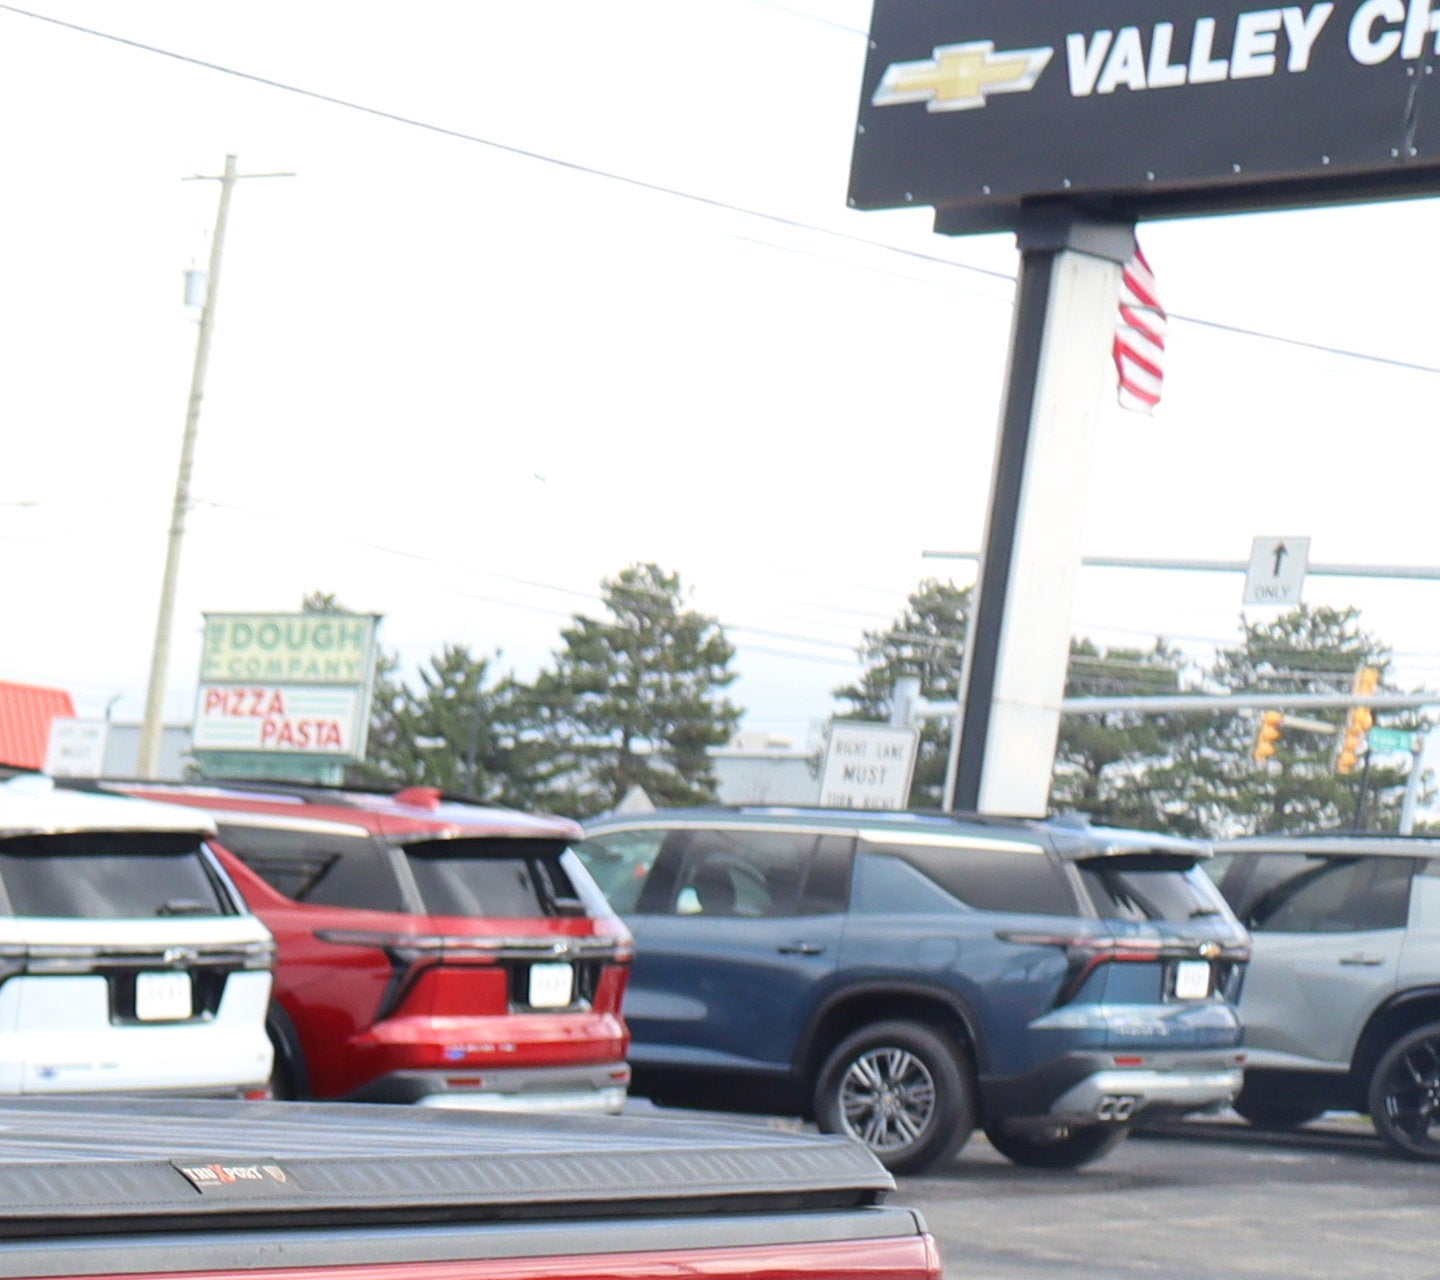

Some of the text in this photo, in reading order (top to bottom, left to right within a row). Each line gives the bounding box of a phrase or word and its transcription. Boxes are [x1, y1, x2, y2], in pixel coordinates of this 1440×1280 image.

[1066, 3, 1334, 97] VALLEY
[1254, 584, 1292, 599] ONLY
[230, 622, 364, 652] DOUGH
[227, 656, 359, 678] COMPANY
[205, 689, 285, 716] PIZZA
[262, 720, 342, 747] PASTA
[835, 739, 904, 760] RIGHT LANE
[843, 763, 888, 786] MUST
